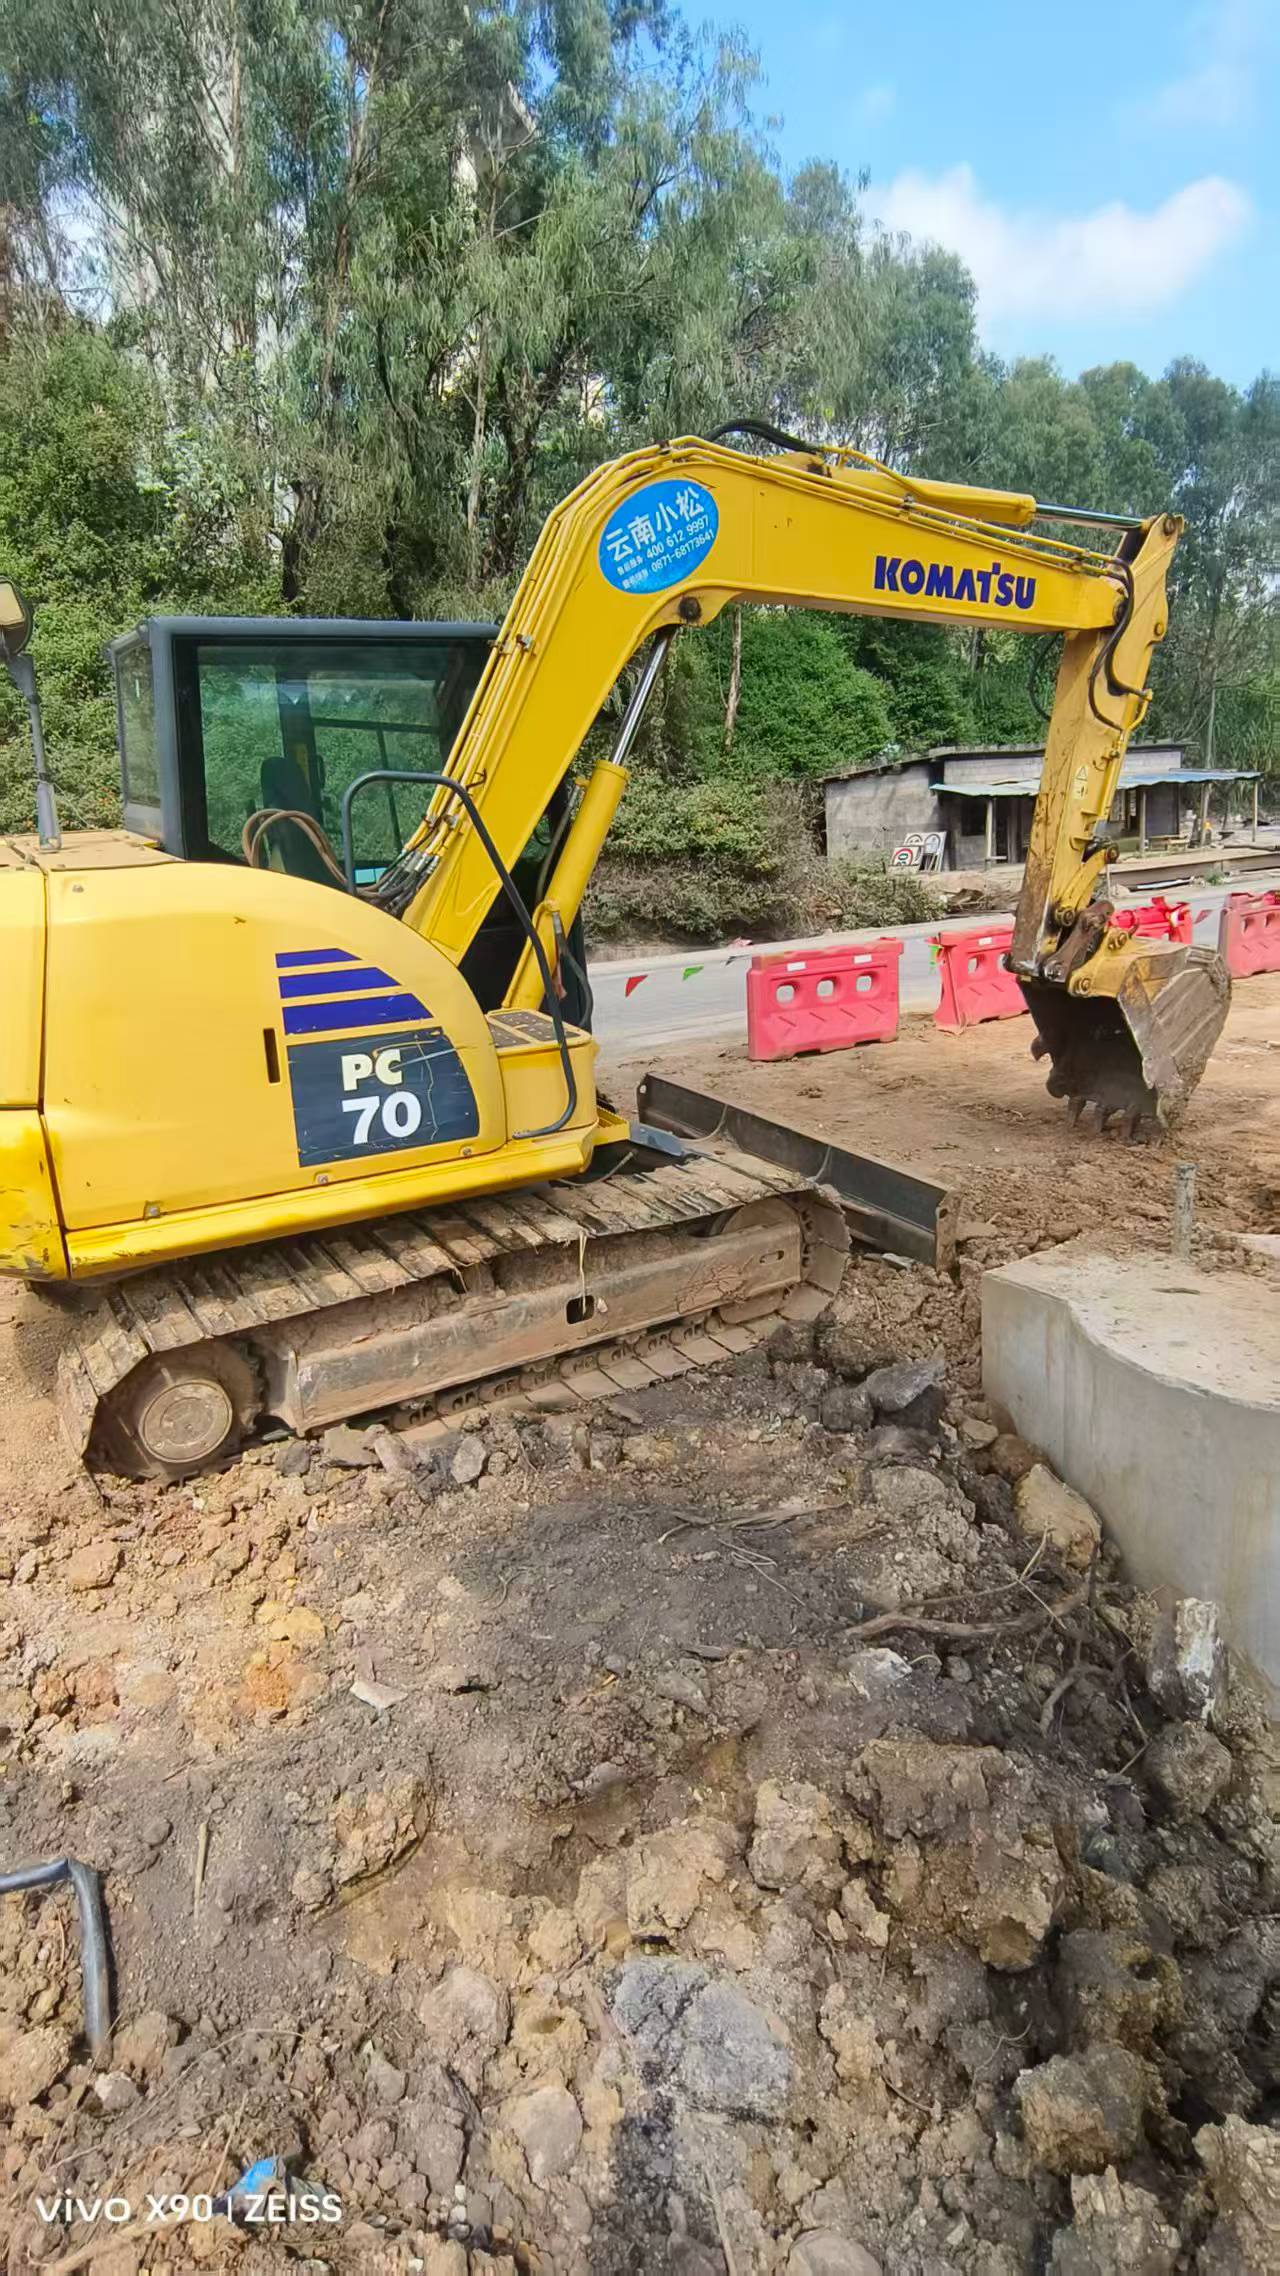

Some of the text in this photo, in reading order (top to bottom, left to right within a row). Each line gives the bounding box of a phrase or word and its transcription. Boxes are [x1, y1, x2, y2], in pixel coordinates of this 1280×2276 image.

[606, 487, 704, 561] 云南小松
[646, 516, 709, 559] 400 612 9997
[873, 556, 1036, 610] KOMATSU
[341, 1049, 402, 1091] PC
[341, 1091, 422, 1145] 70
